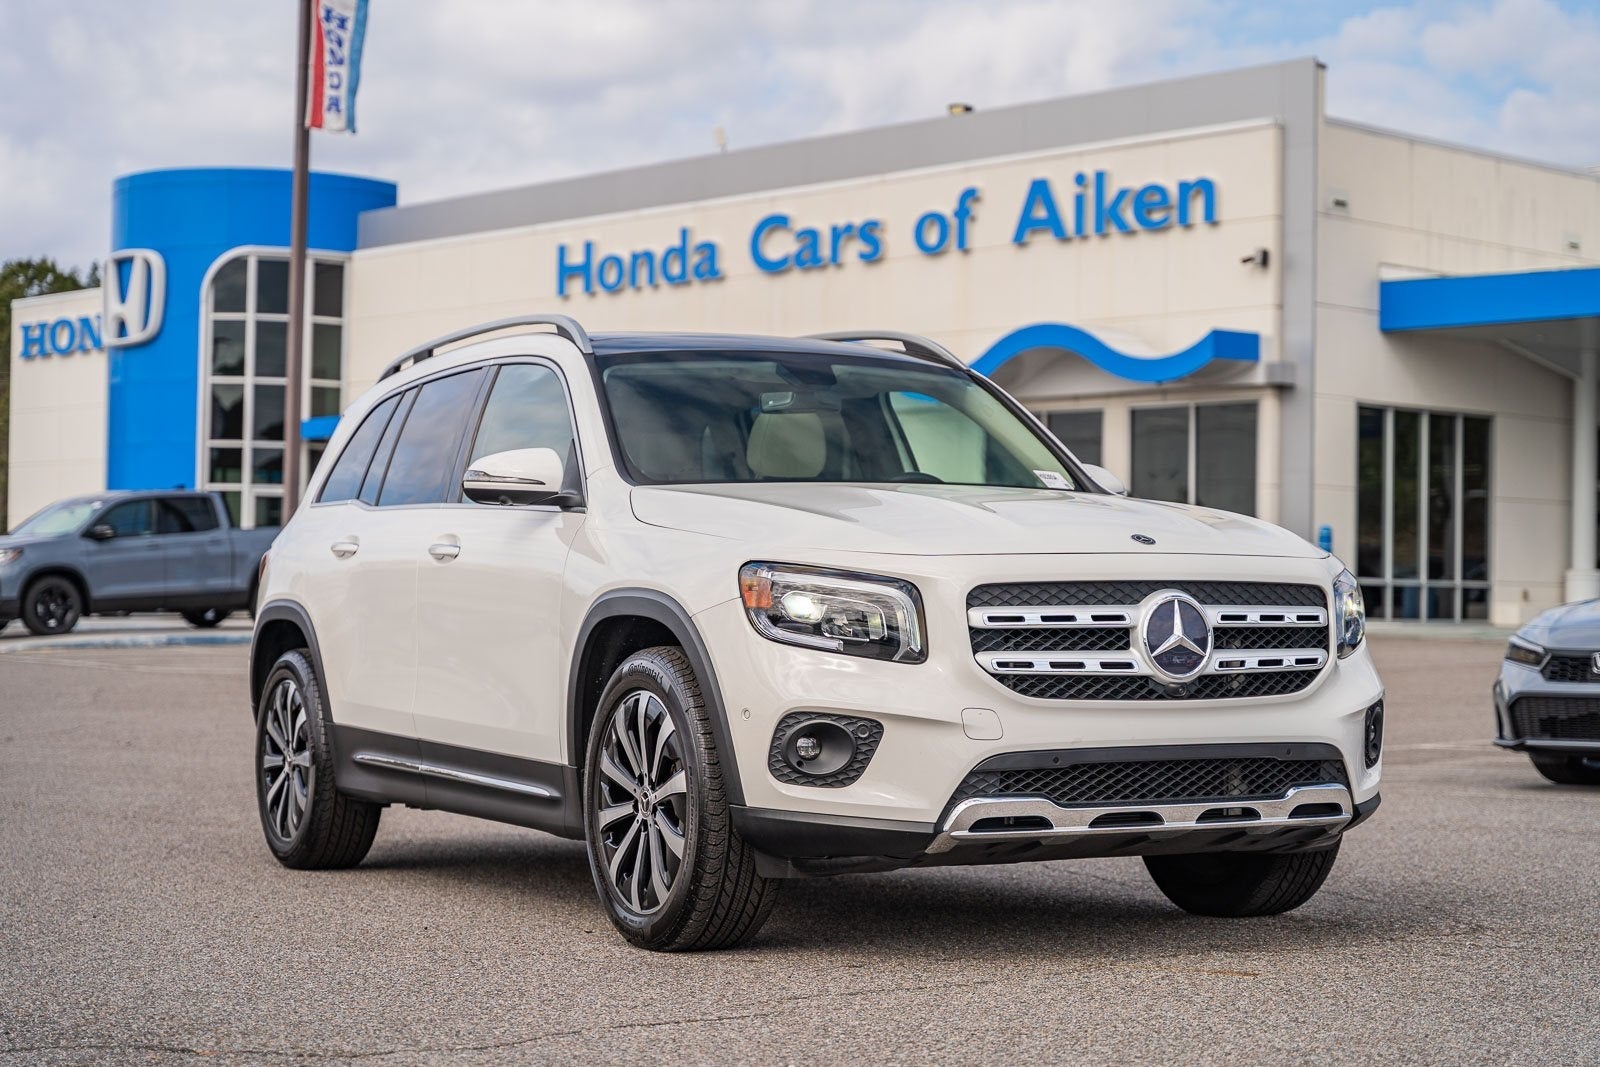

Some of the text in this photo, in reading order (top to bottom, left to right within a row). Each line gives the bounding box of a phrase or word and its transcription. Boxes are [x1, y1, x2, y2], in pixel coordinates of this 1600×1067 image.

[556, 170, 1217, 297] Honda Cars of Aiken
